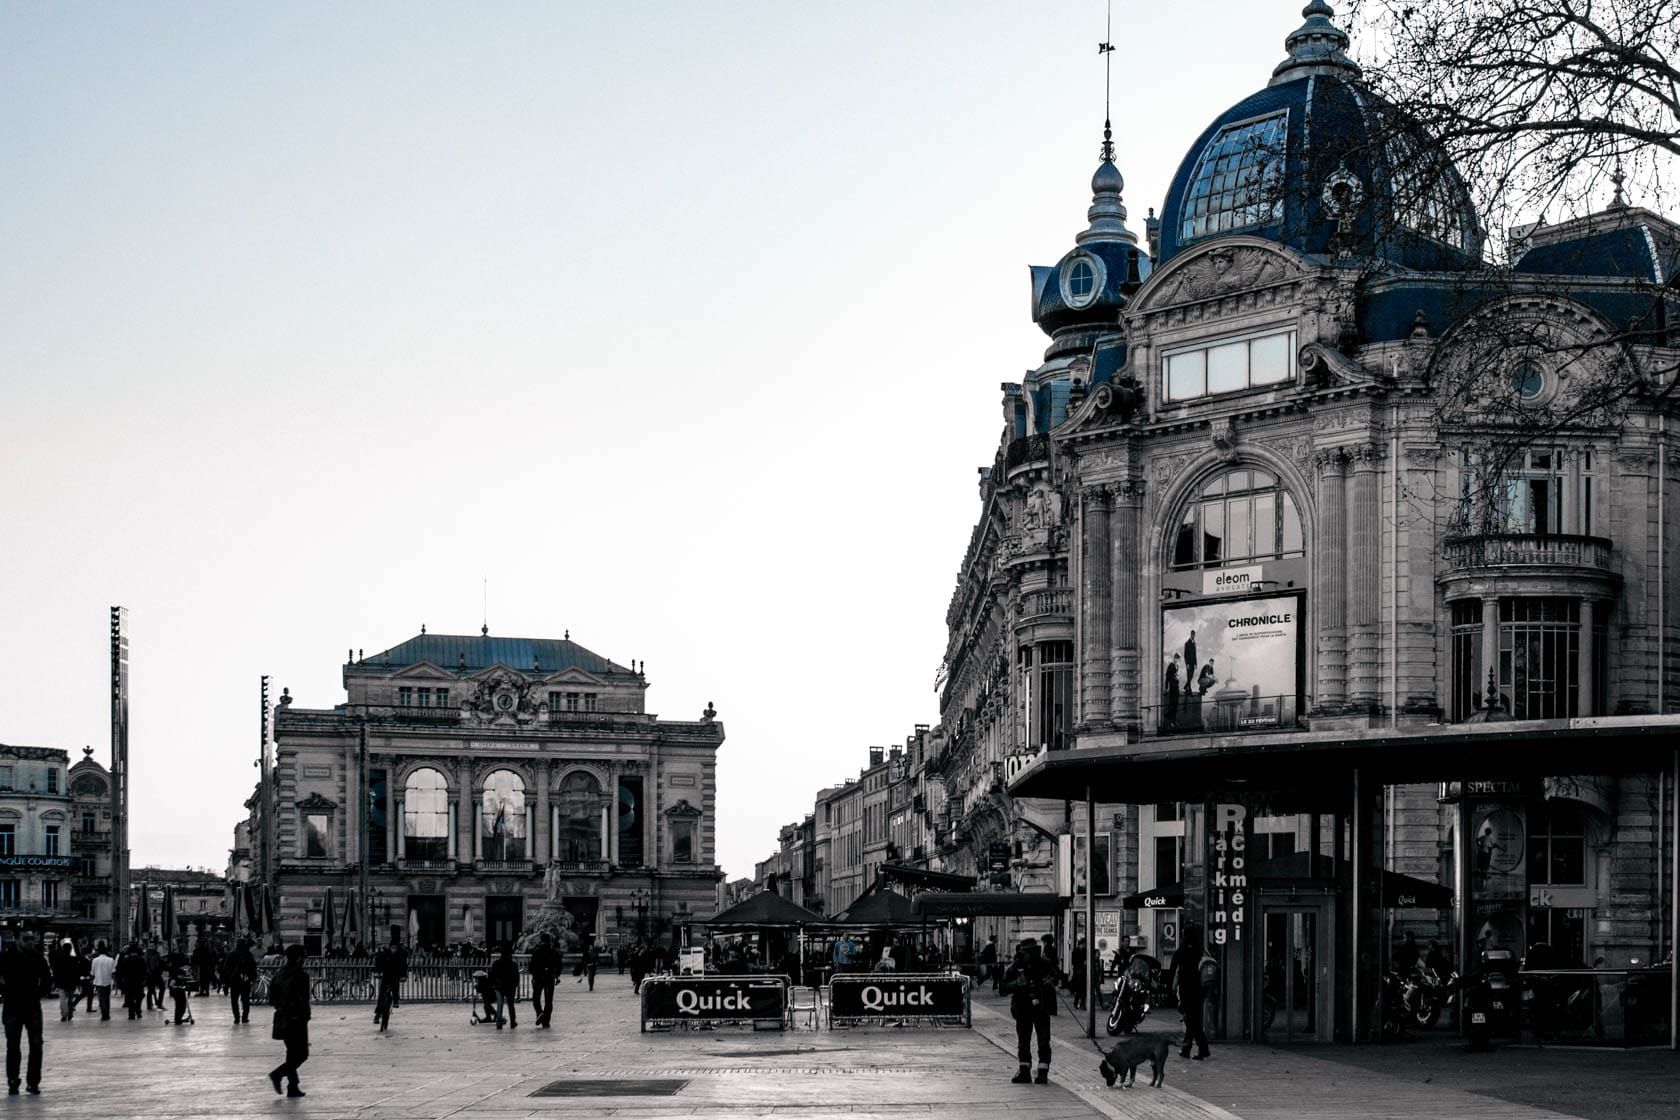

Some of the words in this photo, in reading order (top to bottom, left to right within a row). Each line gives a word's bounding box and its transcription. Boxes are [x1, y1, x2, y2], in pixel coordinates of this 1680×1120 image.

[1228, 613, 1291, 628] CHRONICLE
[0, 857, 26, 866] NQUE
[1144, 896, 1166, 907] Quick
[1398, 895, 1416, 905] Quick
[1164, 924, 1175, 941] Q
[676, 989, 751, 1015] Quick
[861, 985, 934, 1011] Quick
